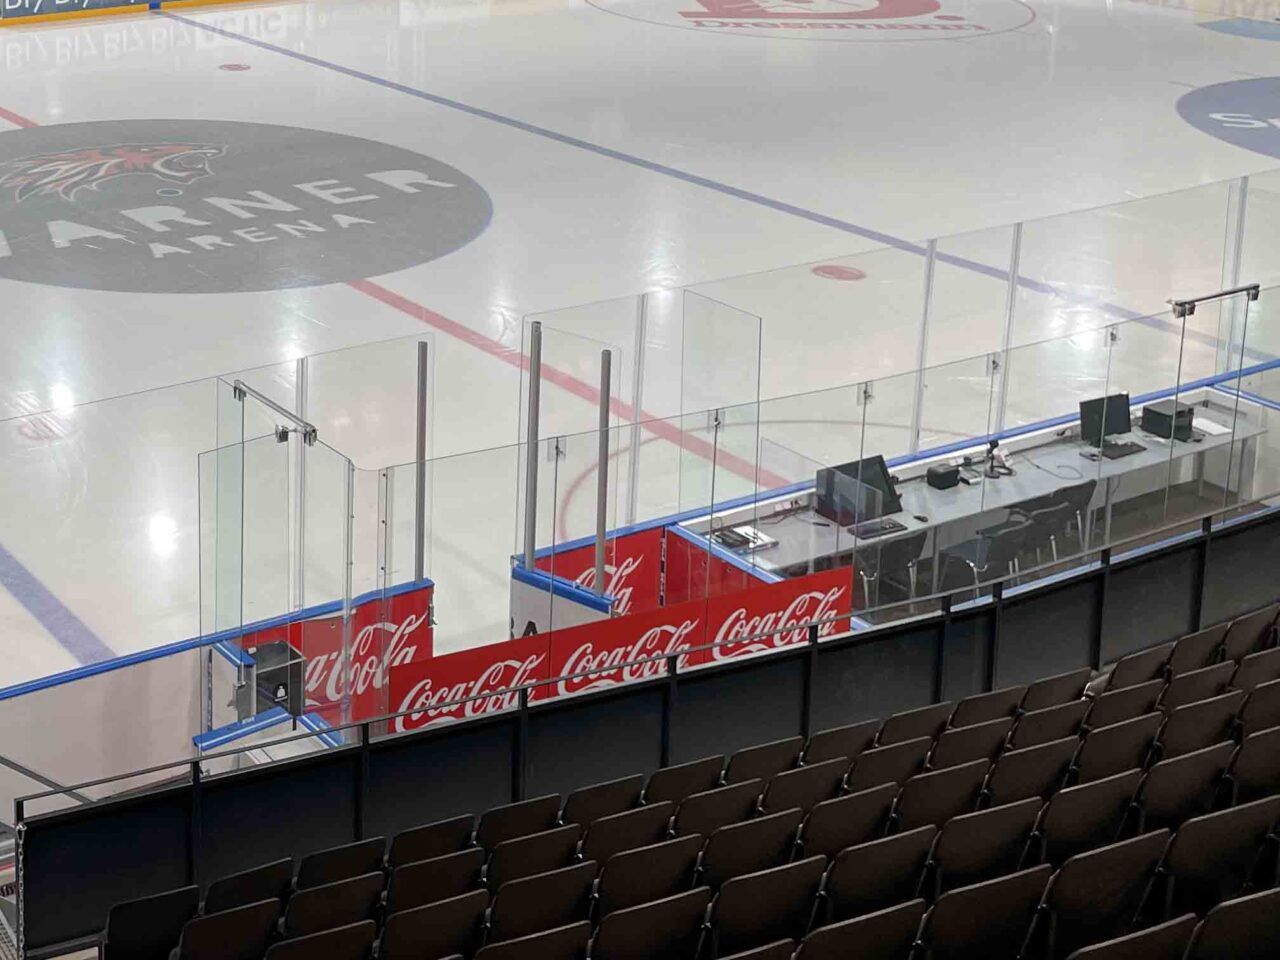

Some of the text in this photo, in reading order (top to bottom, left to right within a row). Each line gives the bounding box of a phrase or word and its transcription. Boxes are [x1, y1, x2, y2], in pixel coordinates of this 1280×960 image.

[147, 212, 377, 259] ARENA
[394, 652, 546, 733] Coca-Cola
[557, 618, 700, 697] Coca-Cola
[712, 585, 847, 661] Coca-Cola
